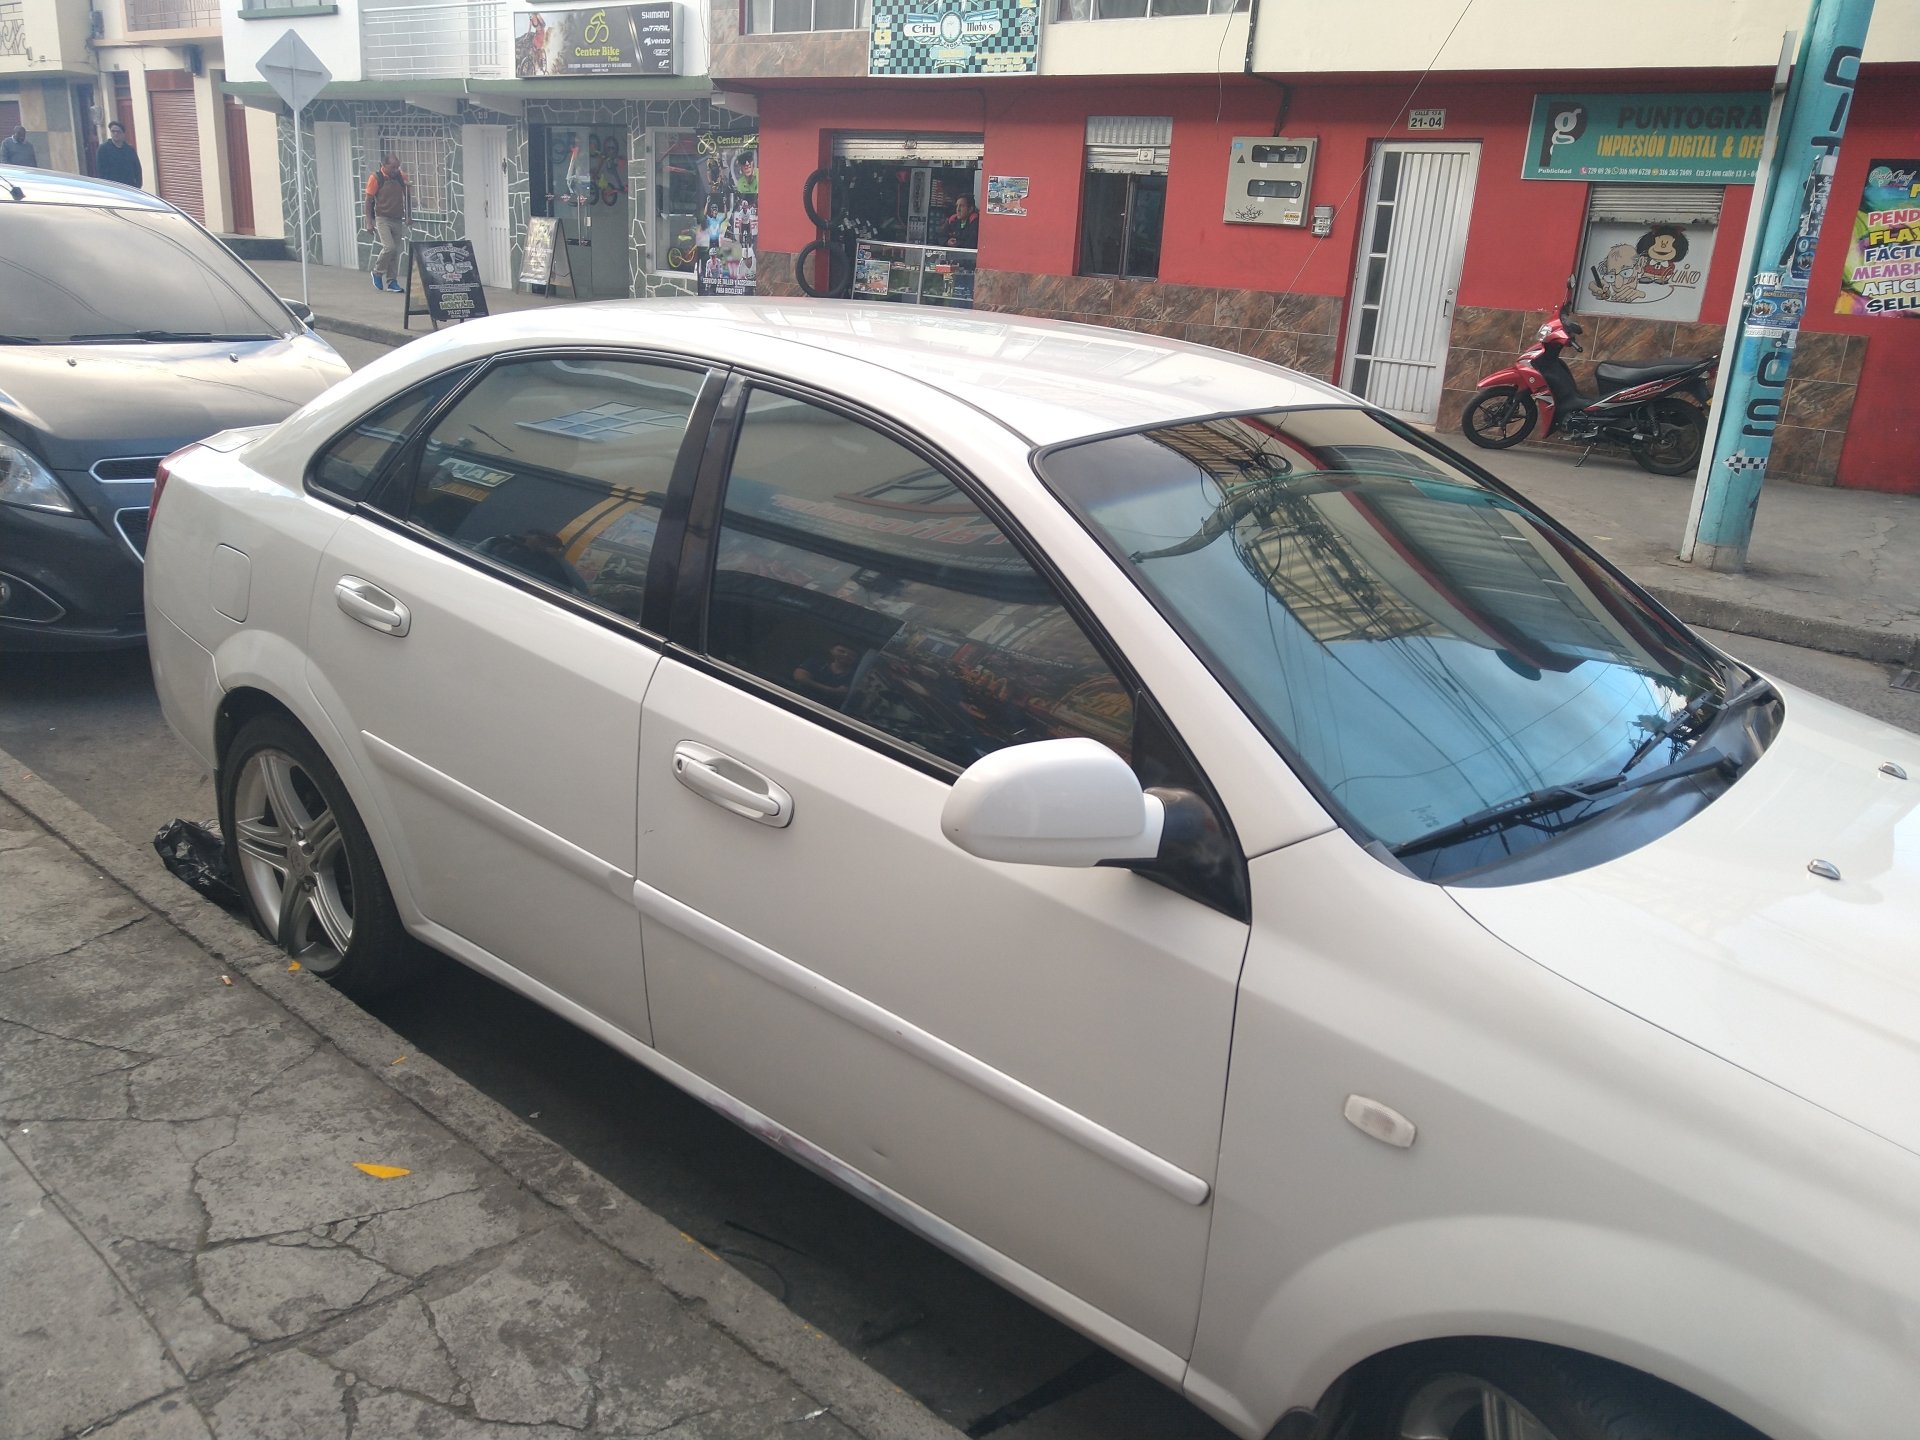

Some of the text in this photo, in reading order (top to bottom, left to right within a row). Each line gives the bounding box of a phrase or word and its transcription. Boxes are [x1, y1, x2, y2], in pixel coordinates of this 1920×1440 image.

[641, 11, 670, 19] SHIMANO
[911, 21, 994, 36] City Moto's
[574, 46, 620, 57] Center Bike
[1410, 116, 1442, 128] 21-04
[1617, 104, 1766, 130] PUNTOGRA
[717, 136, 741, 145] Center
[1597, 134, 1666, 157] IMPRESIÓN
[1668, 135, 1717, 158] DIGITAL
[1722, 136, 1734, 159] &
